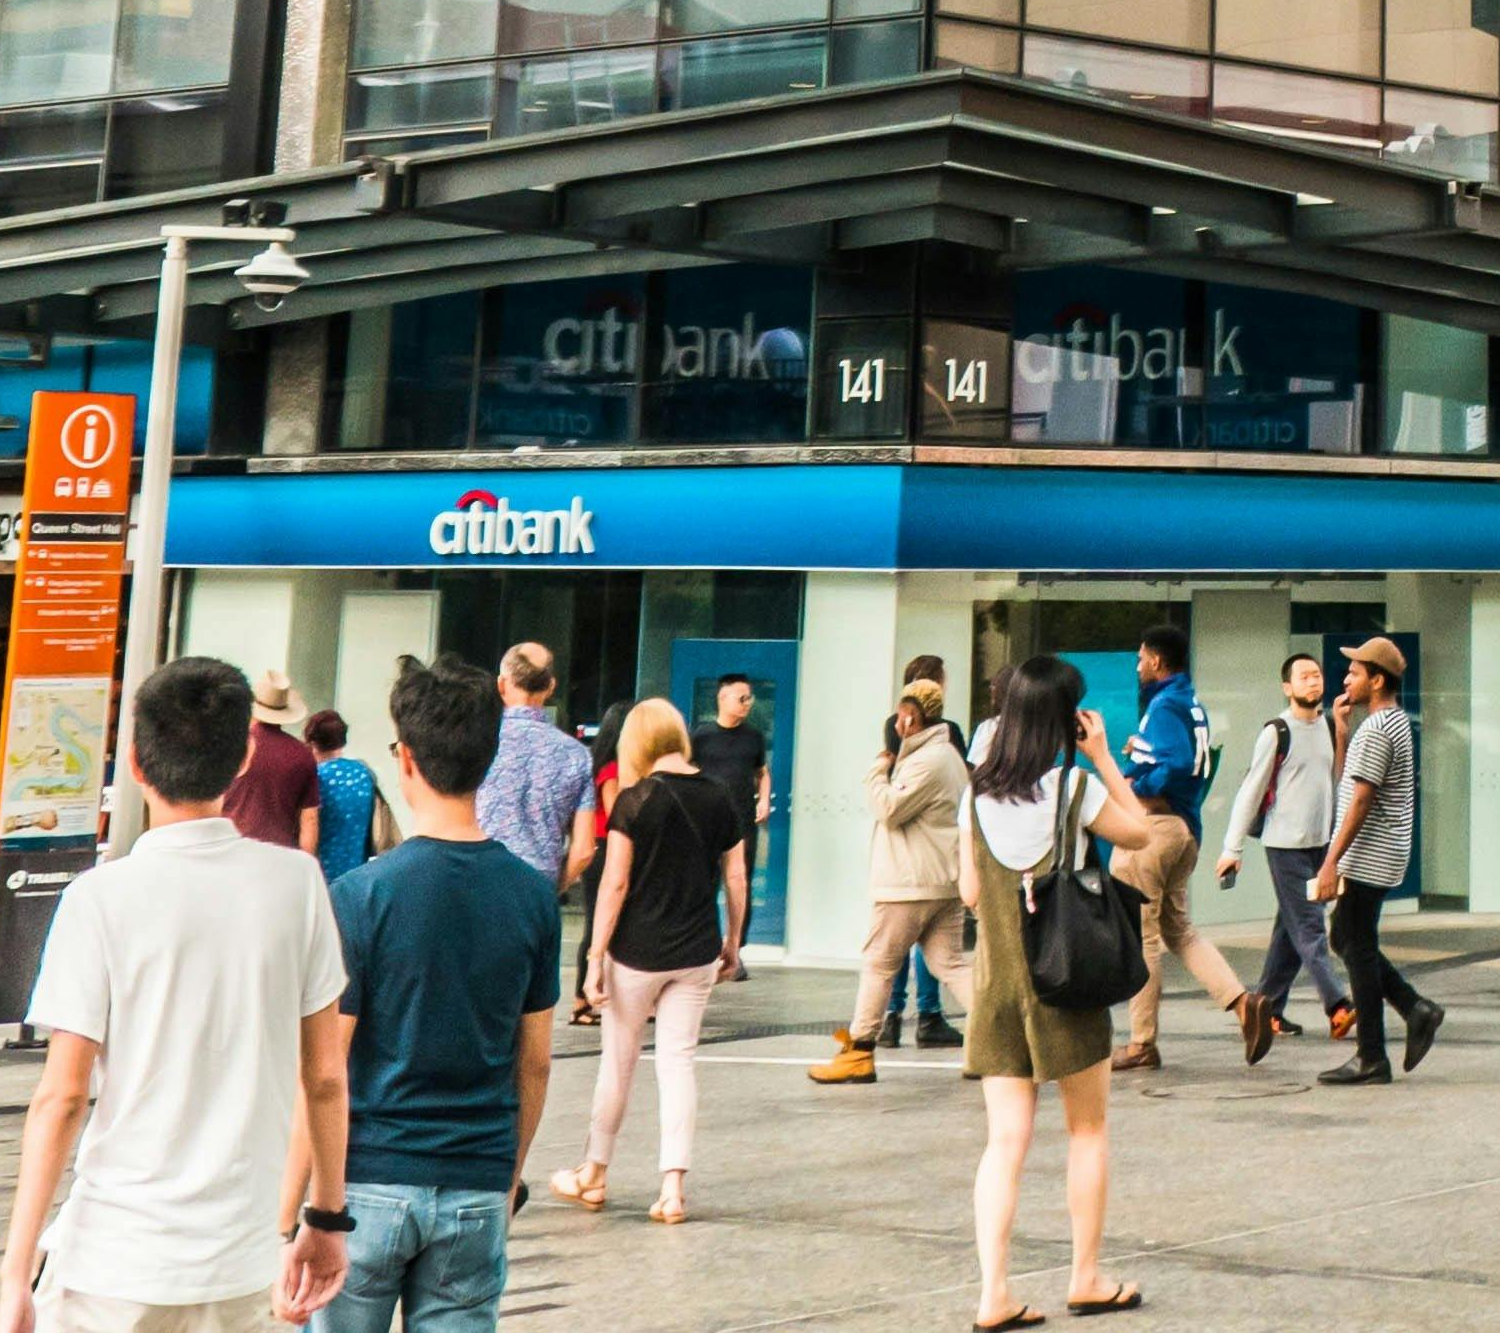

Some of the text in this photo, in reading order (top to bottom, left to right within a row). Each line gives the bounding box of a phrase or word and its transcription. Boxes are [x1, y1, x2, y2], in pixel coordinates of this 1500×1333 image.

[839, 358, 884, 403] 141
[945, 358, 987, 403] 141
[31, 522, 68, 535] Queen
[70, 523, 101, 535] Street
[429, 495, 596, 556] citibank
